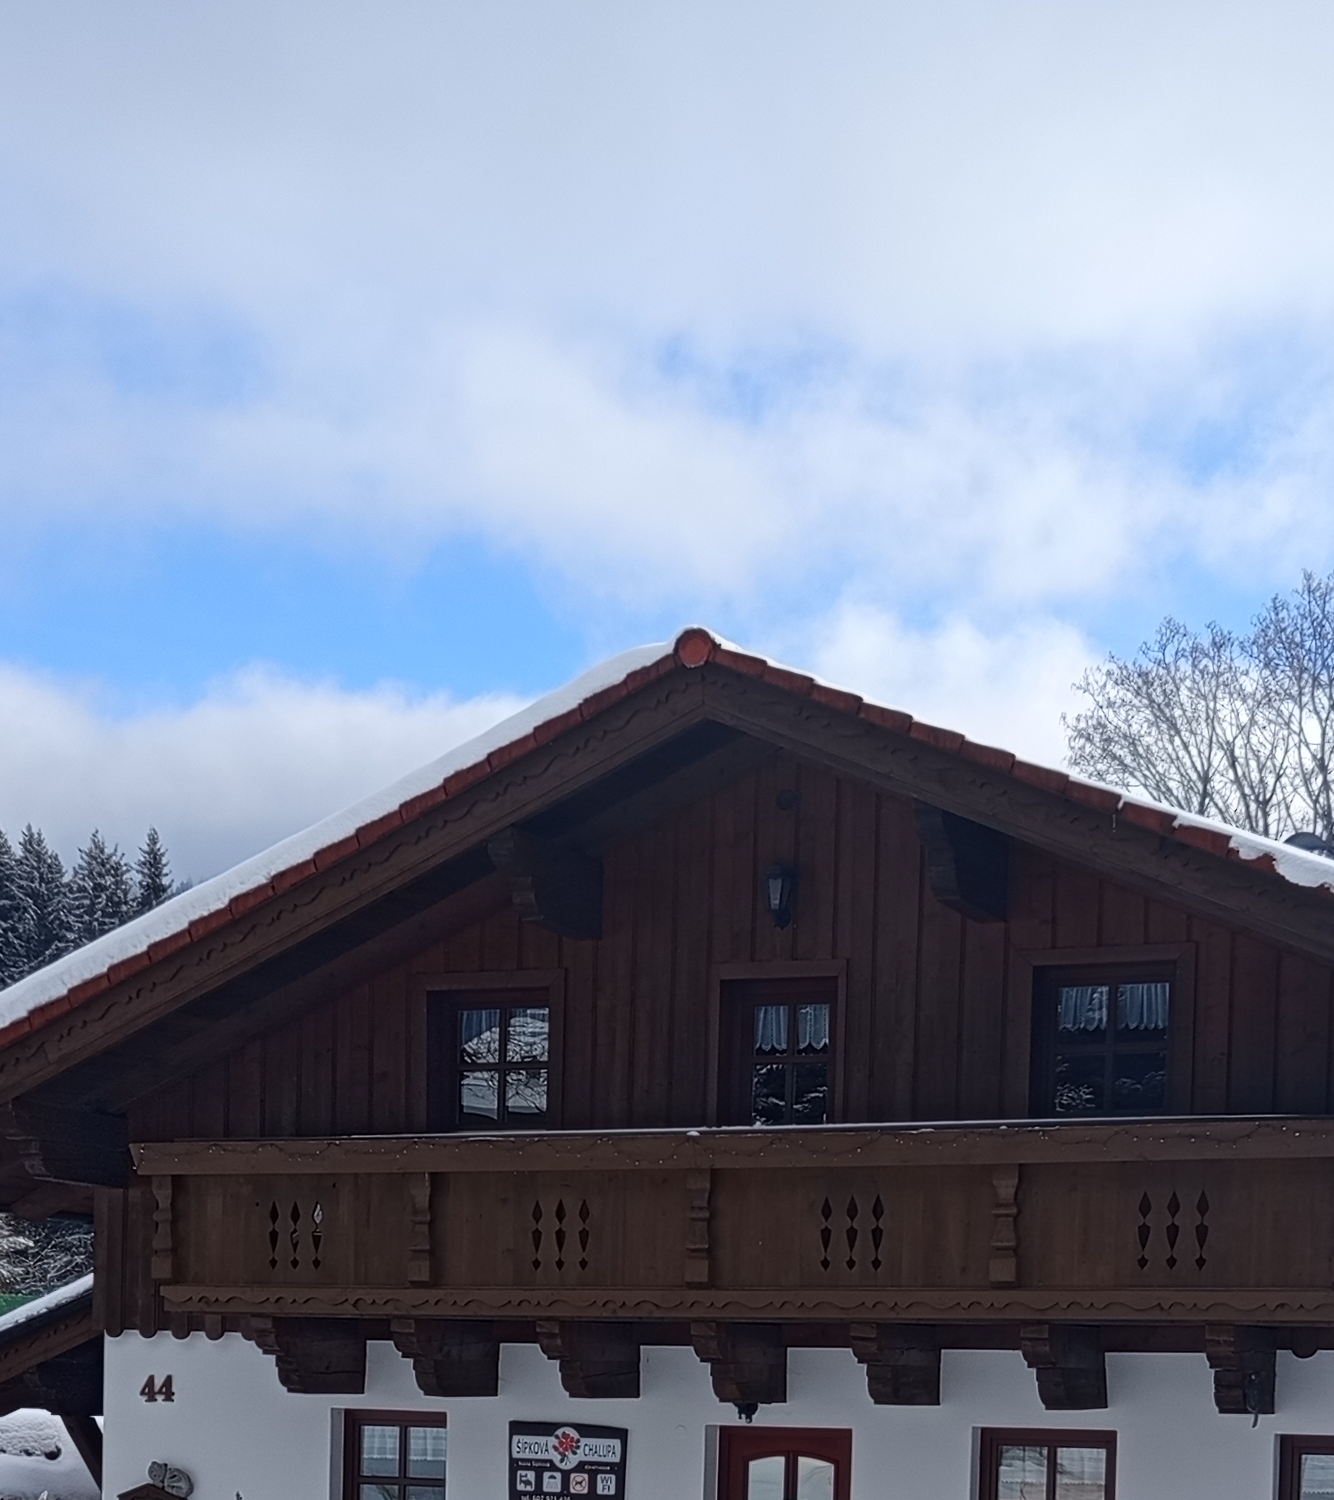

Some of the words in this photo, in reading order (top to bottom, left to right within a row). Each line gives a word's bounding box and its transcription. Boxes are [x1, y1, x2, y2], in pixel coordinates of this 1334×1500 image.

[139, 1374, 175, 1403] 44
[516, 1438, 550, 1455] ŠÍPKOVÁ
[583, 1443, 617, 1458] CHALUPA
[600, 1476, 612, 1485] WI
[602, 1485, 611, 1493] FI
